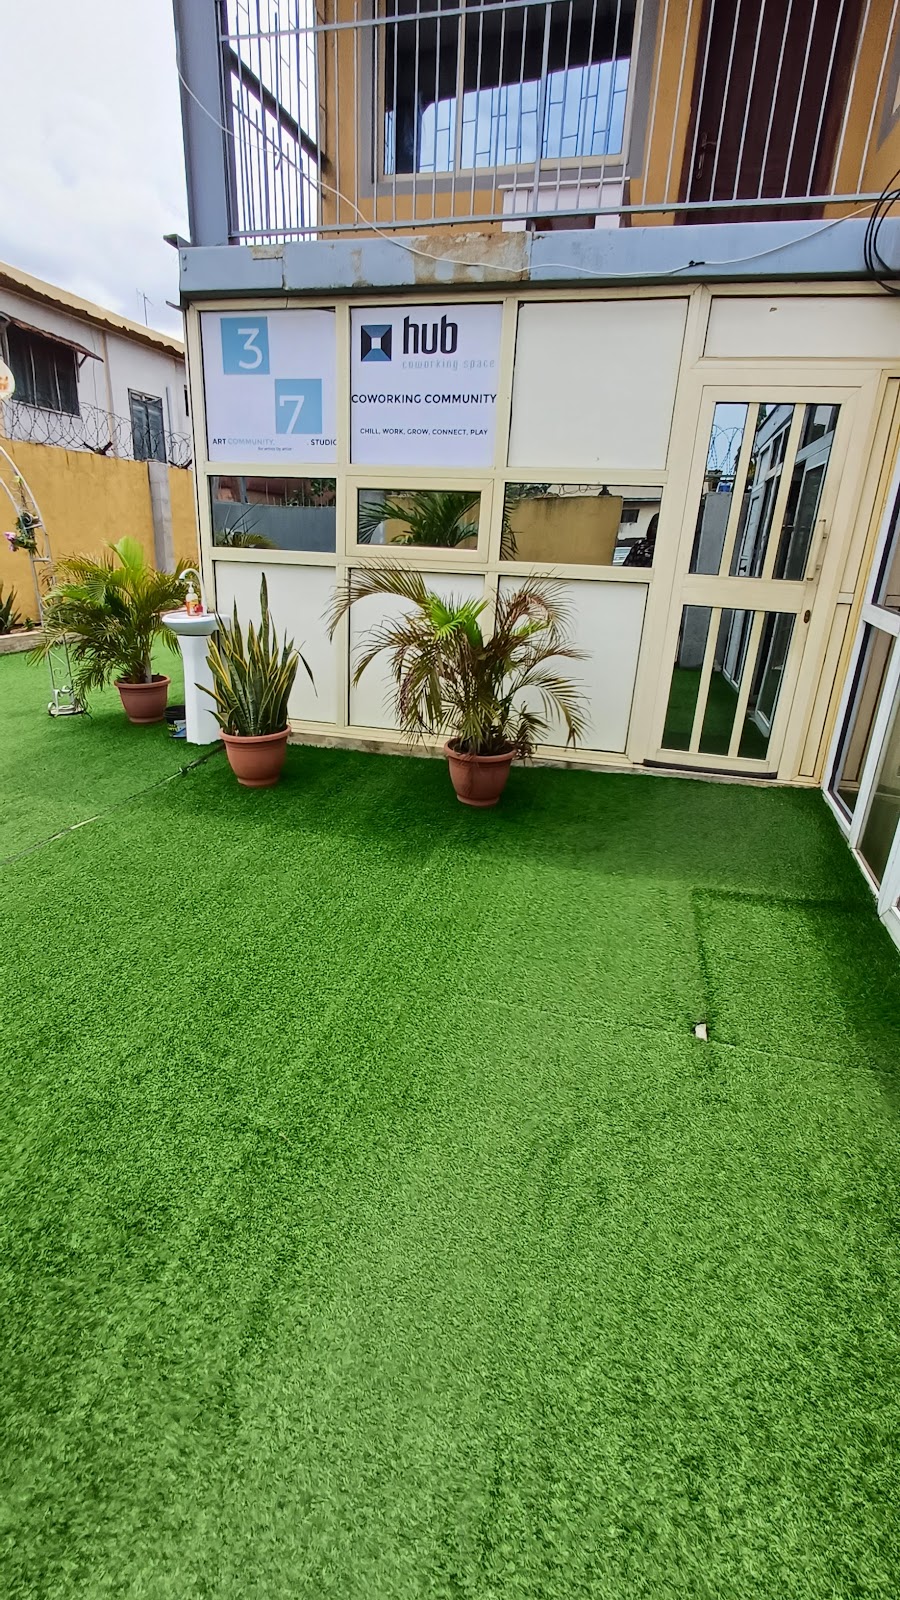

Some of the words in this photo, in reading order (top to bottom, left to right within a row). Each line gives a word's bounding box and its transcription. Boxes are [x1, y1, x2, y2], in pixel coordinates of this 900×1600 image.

[402, 314, 458, 355] hub
[237, 328, 263, 370] 3
[402, 359, 459, 371] coworking
[463, 359, 495, 370] space
[351, 394, 422, 404] COWORKING
[424, 393, 497, 404] COMMUNITY
[279, 395, 305, 434] 7
[406, 428, 430, 436] GROW,
[432, 428, 468, 436] CONNECT,
